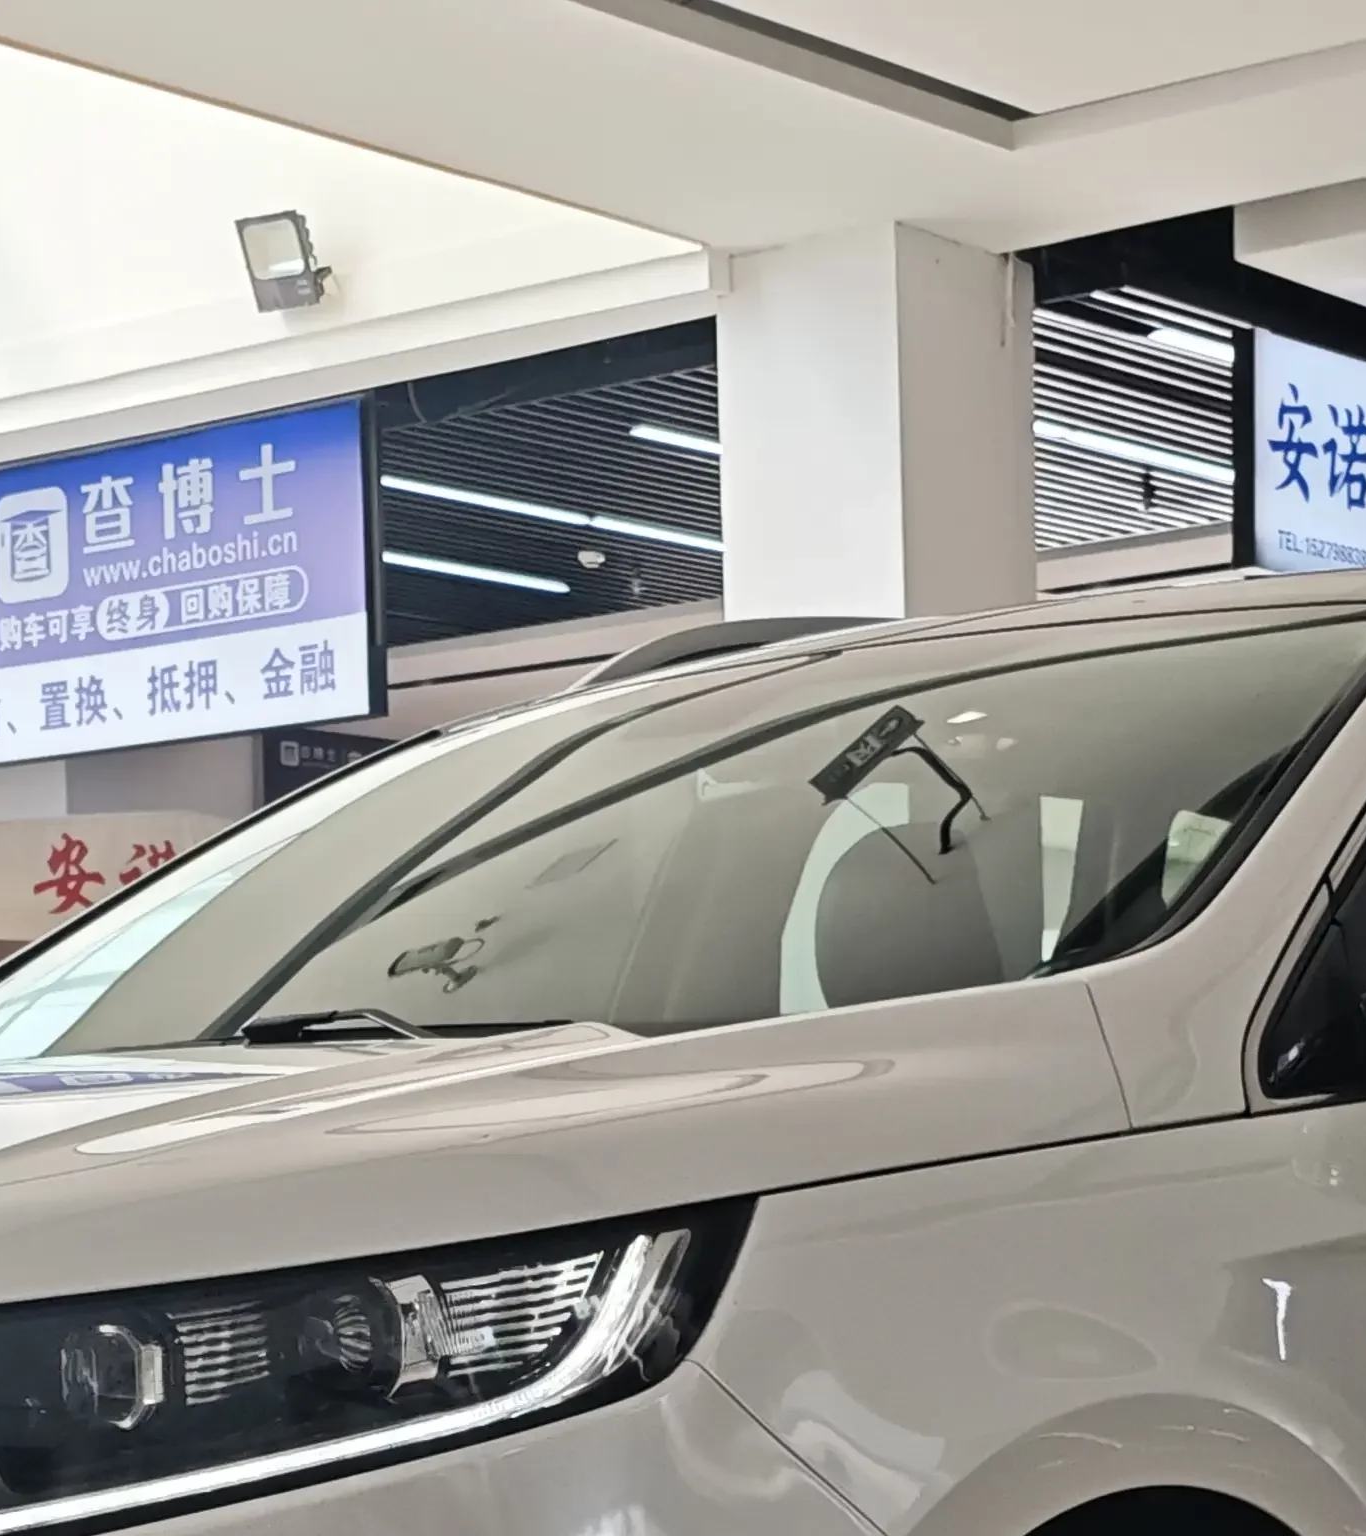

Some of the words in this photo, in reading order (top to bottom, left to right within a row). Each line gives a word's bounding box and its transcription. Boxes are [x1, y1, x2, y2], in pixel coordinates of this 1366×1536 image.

[81, 443, 297, 554] 查博士
[83, 531, 298, 588] www.chaboshi.cn
